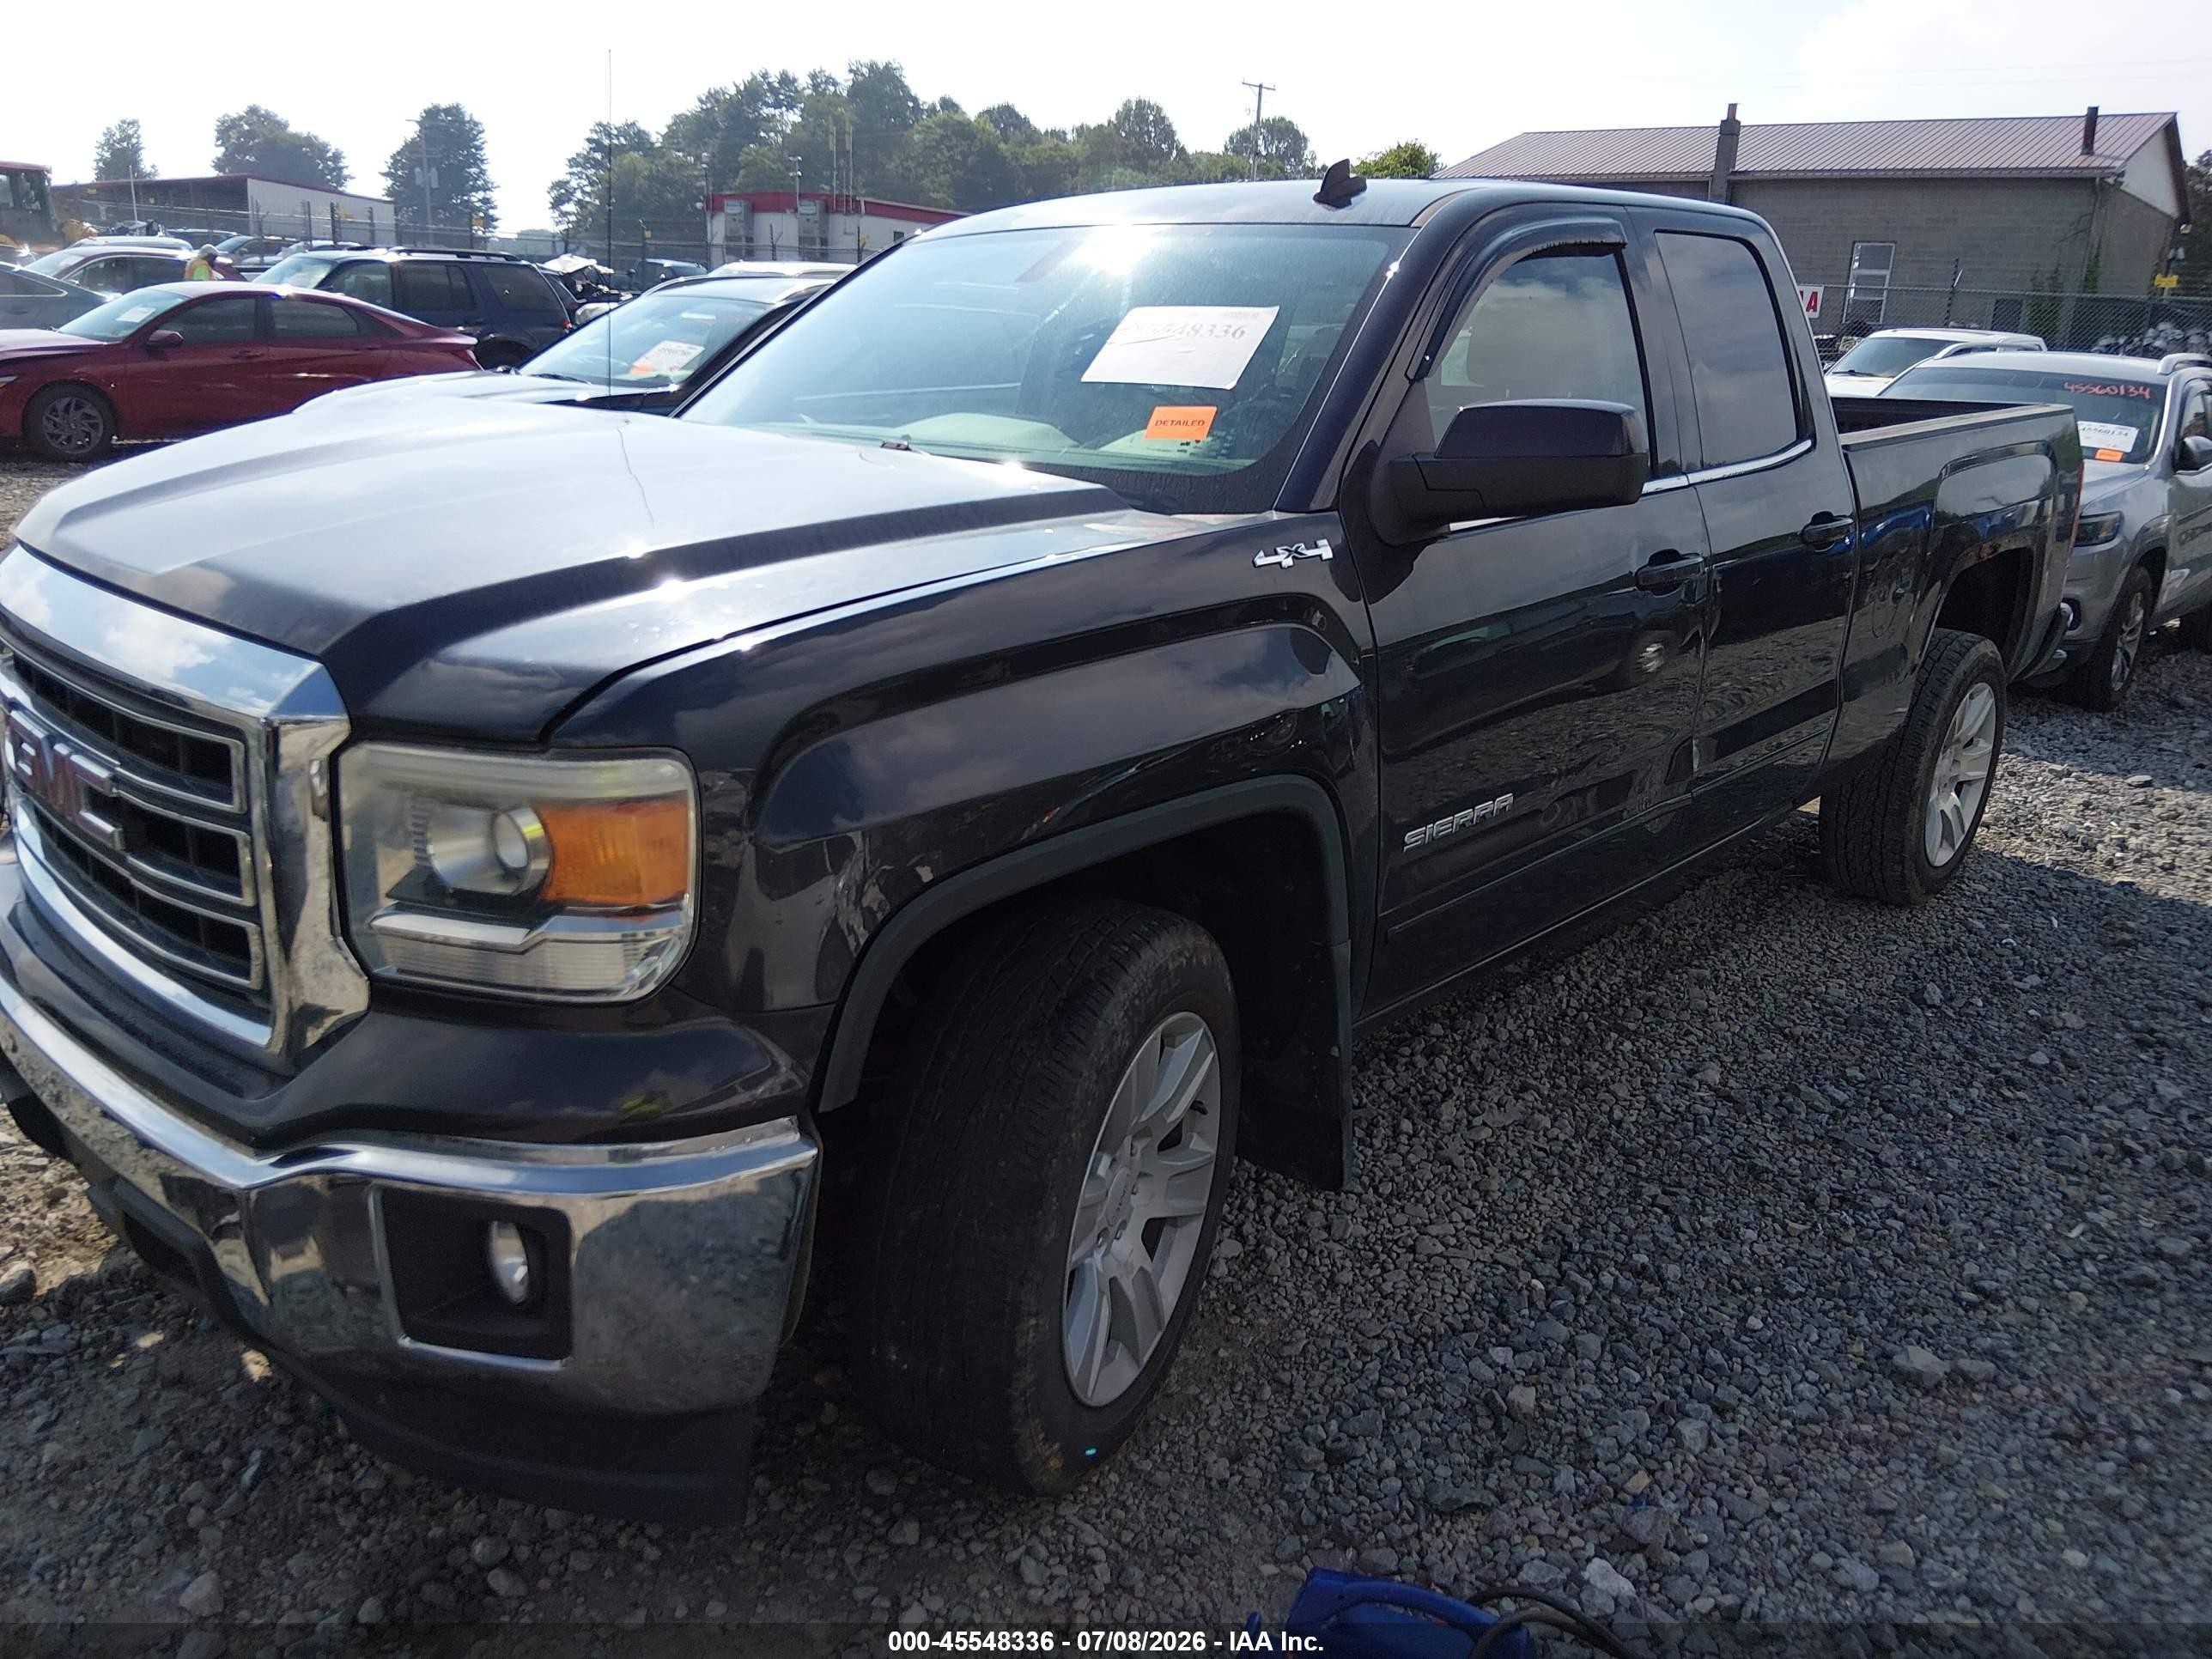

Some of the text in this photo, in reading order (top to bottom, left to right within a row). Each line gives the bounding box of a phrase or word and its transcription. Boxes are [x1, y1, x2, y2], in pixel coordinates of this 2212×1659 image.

[2064, 382, 2151, 399] 45560134
[5, 708, 125, 852] GMC
[1402, 793, 1514, 853] SIERRA
